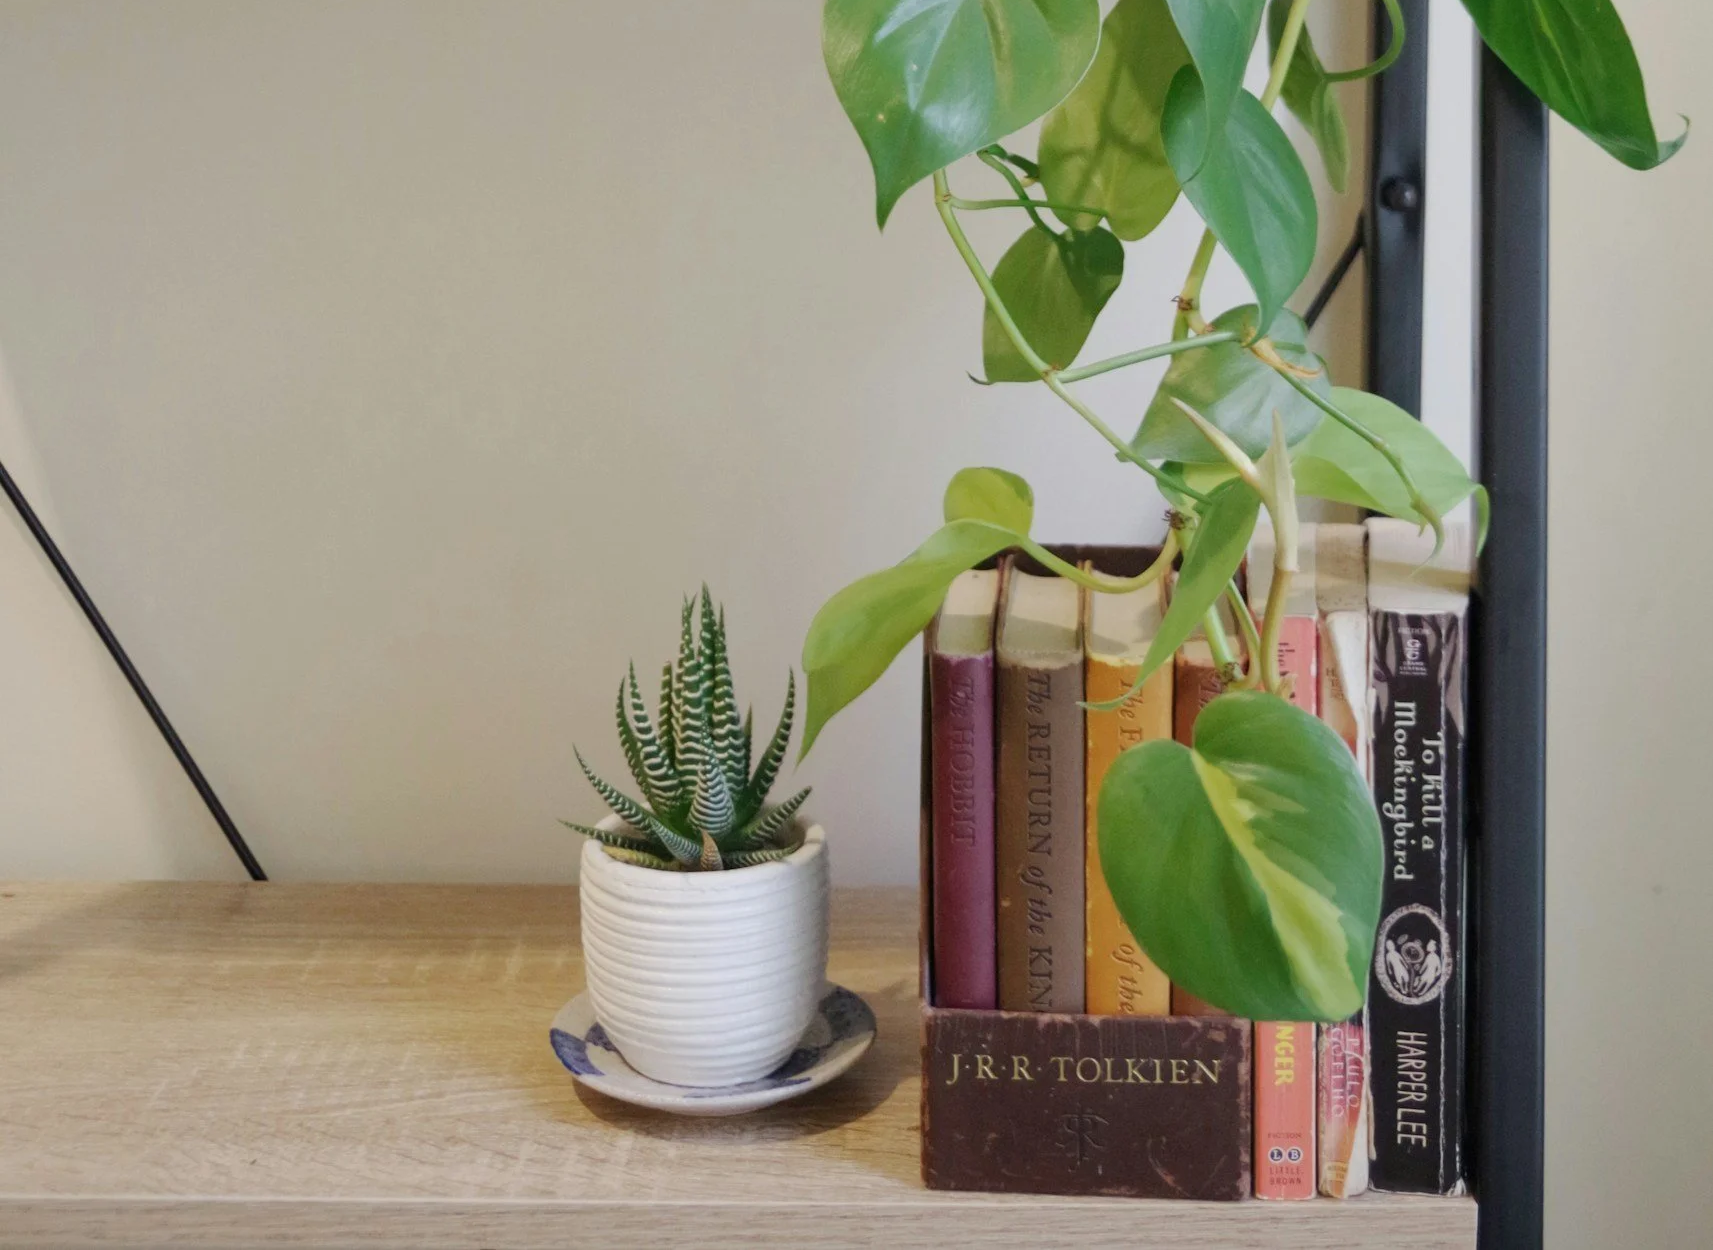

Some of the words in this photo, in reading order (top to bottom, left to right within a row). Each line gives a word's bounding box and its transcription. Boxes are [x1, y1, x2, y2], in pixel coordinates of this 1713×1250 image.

[1027, 673, 1051, 714] The
[1421, 731, 1445, 764] To
[950, 727, 976, 846] HOBBIT
[1027, 722, 1052, 857] RETURN
[1421, 835, 1435, 851] a
[1021, 864, 1053, 895] of
[1027, 899, 1053, 935] the
[1111, 943, 1145, 973] of
[1028, 945, 1053, 1012] KIN
[1118, 975, 1144, 1013] the
[1050, 1055, 1222, 1085] TOLKIEN
[1396, 1030, 1428, 1102] HARPER
[1396, 1110, 1428, 1147] LEE
[1270, 1177, 1302, 1185] BROWN
